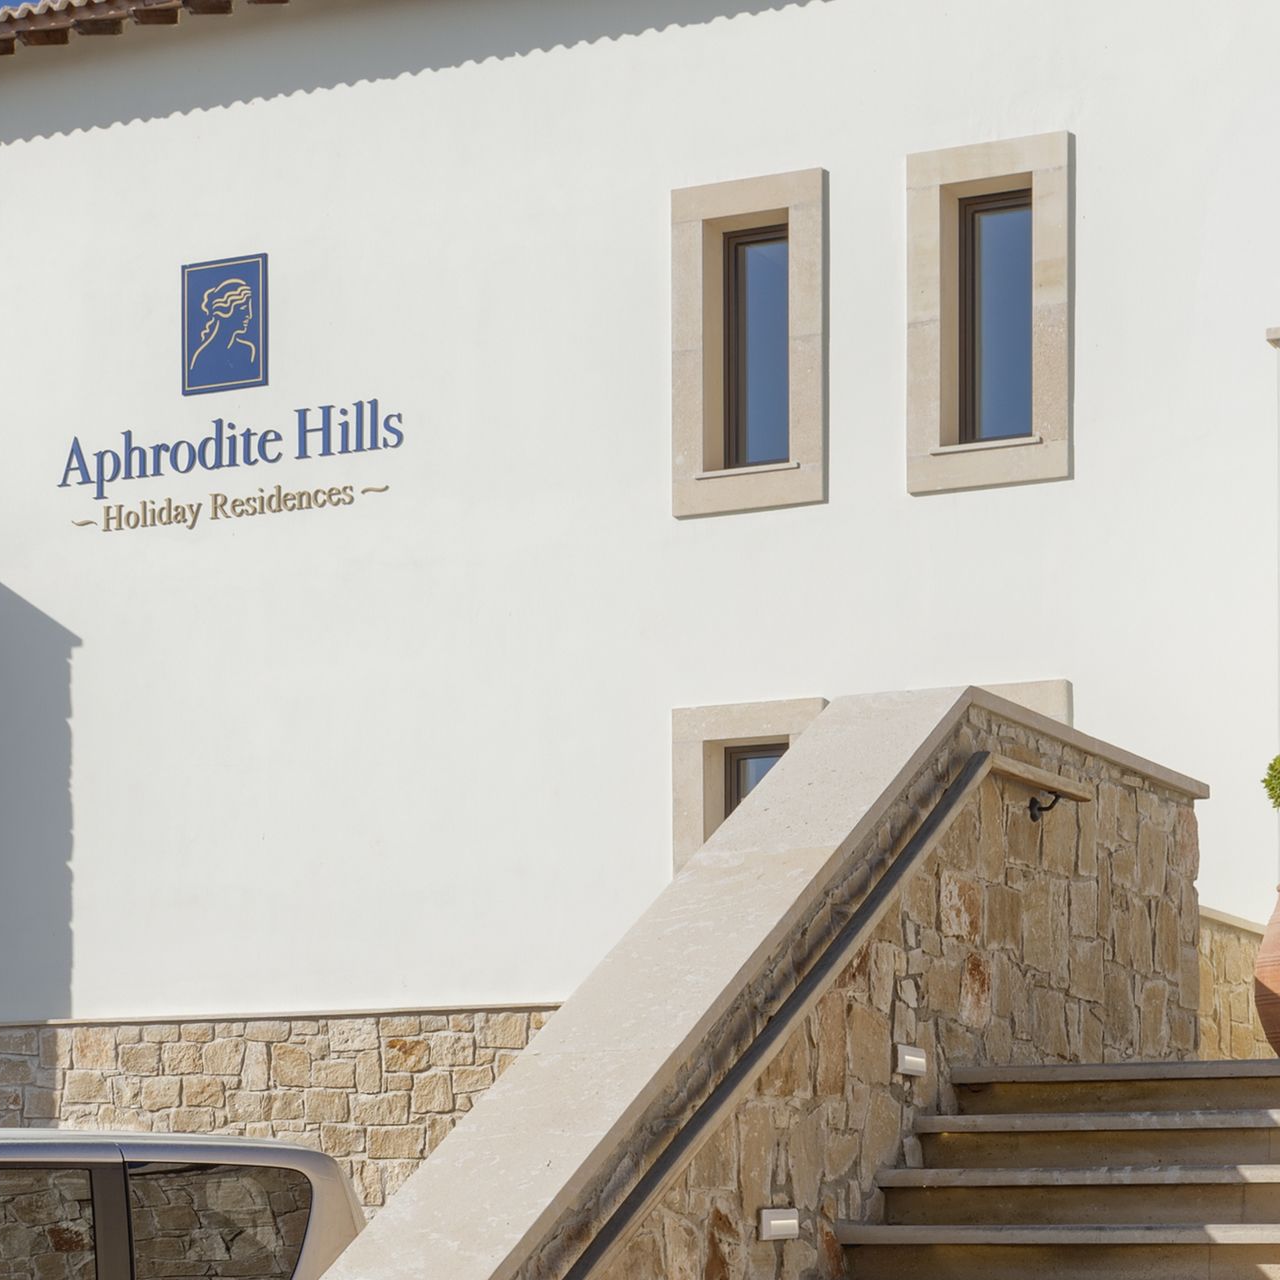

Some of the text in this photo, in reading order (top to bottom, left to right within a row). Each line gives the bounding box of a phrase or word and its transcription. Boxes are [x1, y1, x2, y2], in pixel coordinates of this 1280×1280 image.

[57, 398, 404, 499] Aphrodite Hills
[102, 485, 354, 532] Holiday Residences
